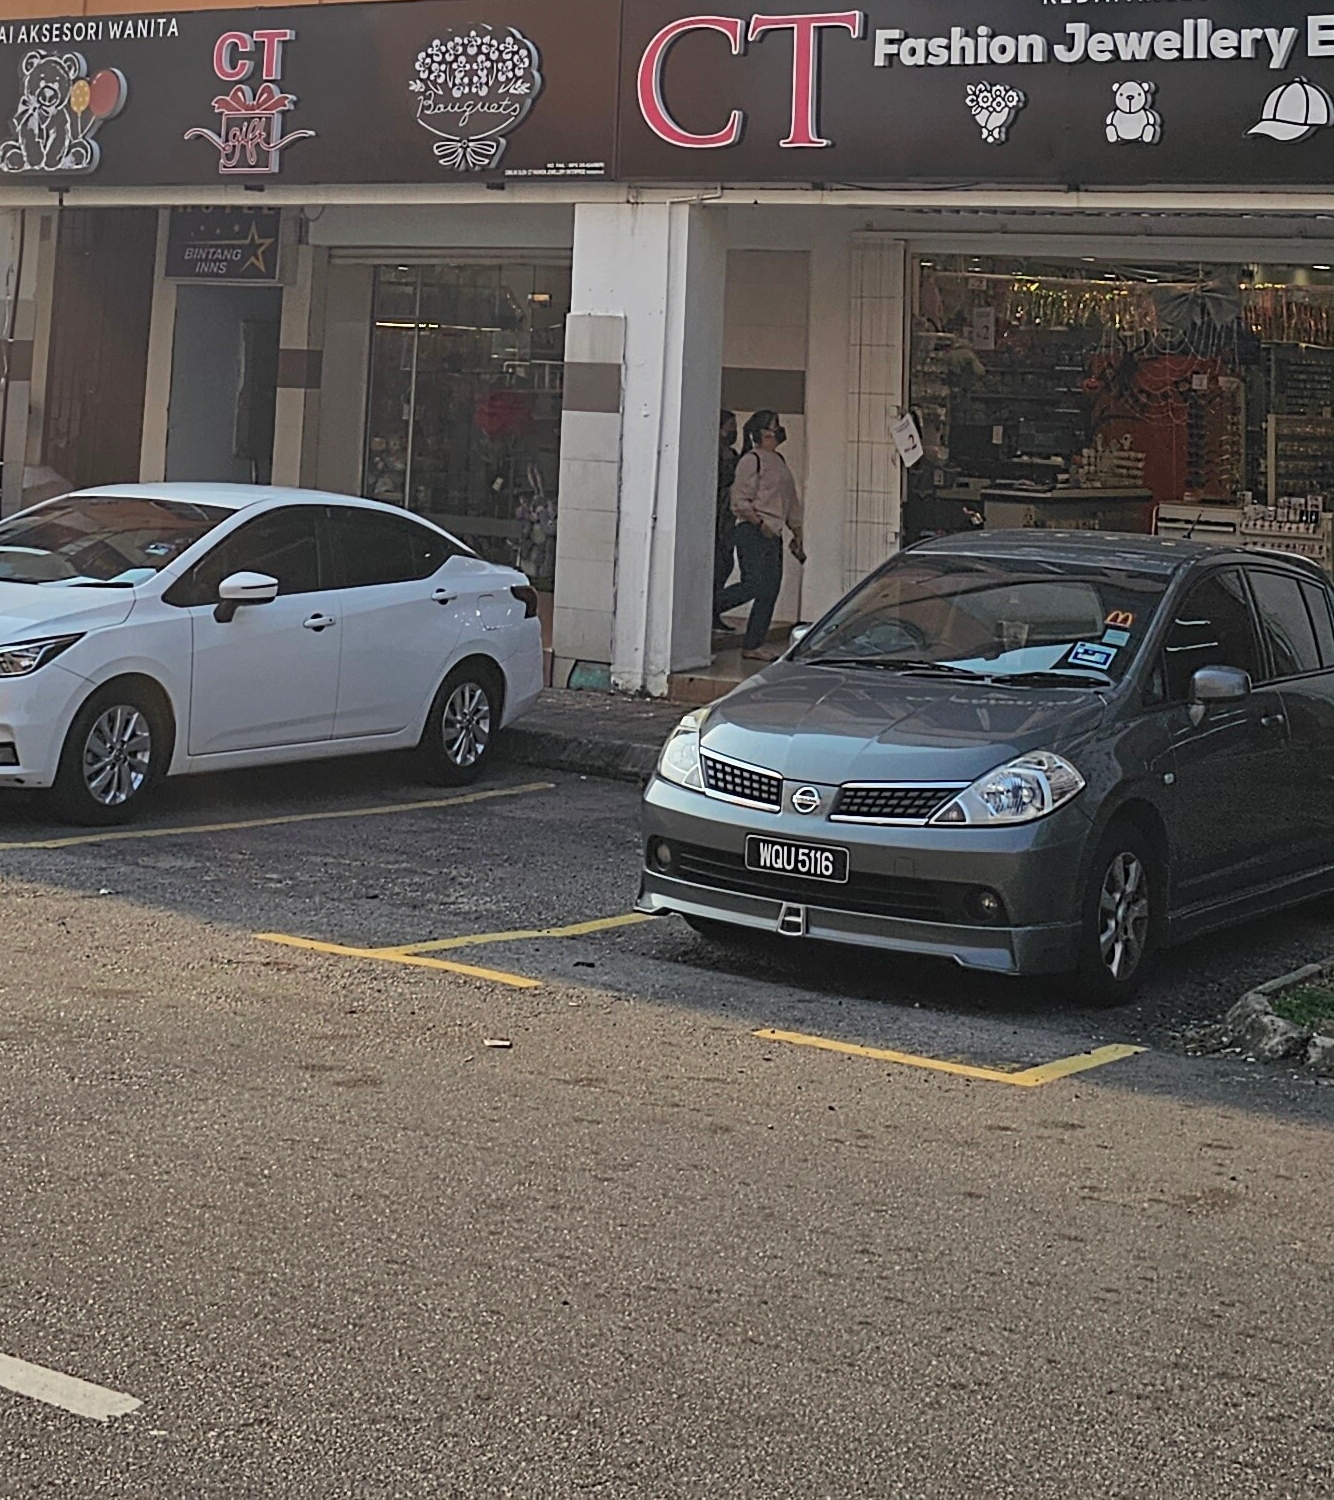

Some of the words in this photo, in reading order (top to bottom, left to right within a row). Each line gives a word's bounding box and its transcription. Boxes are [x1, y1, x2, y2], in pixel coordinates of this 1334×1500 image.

[16, 20, 104, 44] AKSESORI
[107, 17, 180, 40] WANITA
[873, 25, 1048, 67] Fashion
[1053, 17, 1298, 71] Jewellery
[212, 28, 295, 80] CT
[637, 9, 865, 149] CT
[416, 94, 522, 125] Bouquets
[184, 247, 243, 261] BINTANG
[195, 261, 228, 274] INNS
[759, 842, 796, 871] WQU
[797, 847, 834, 877] 5116
